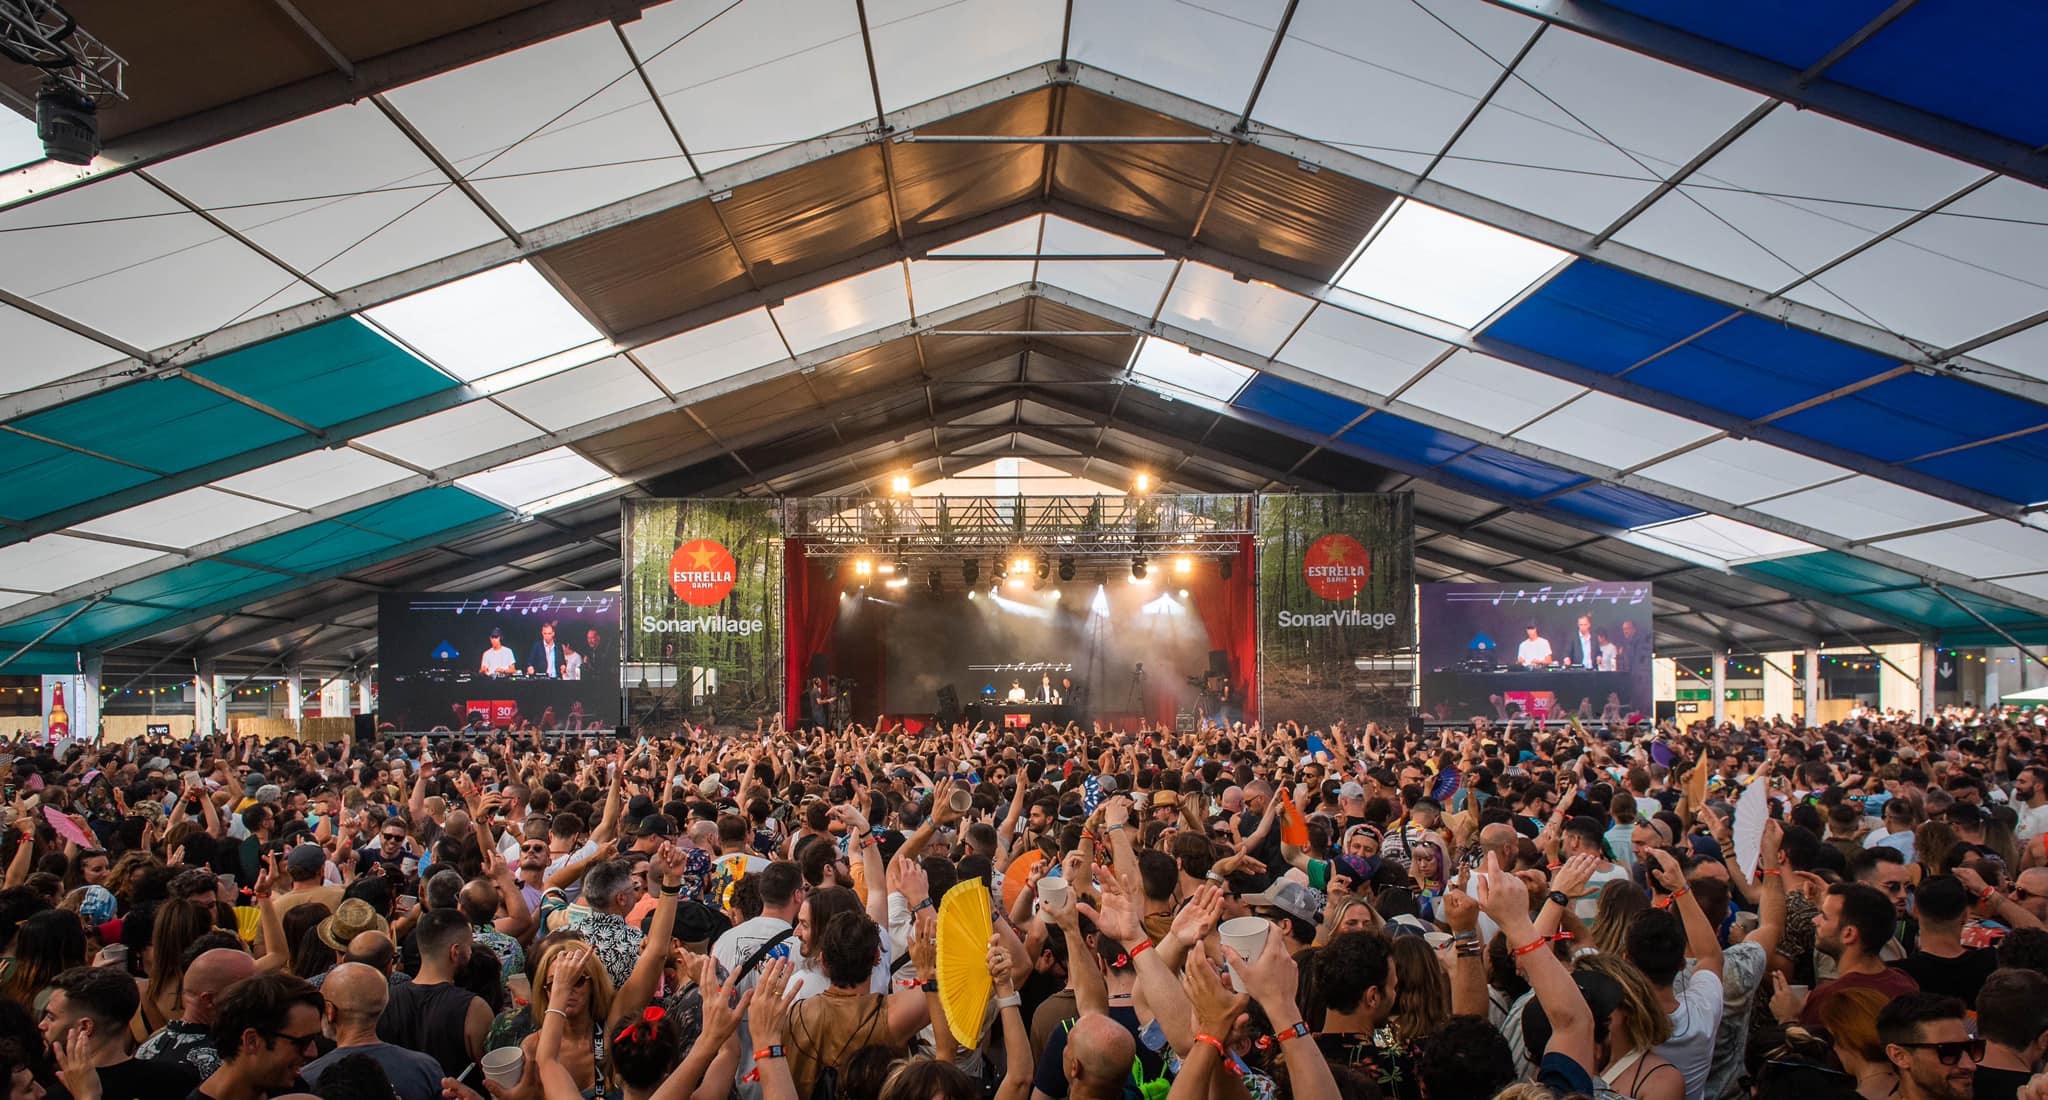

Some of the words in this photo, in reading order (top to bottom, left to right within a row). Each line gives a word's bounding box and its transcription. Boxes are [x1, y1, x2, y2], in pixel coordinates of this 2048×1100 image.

[674, 571, 731, 582] ESTRELLA
[1308, 566, 1365, 577] ESTRELLA
[643, 616, 763, 636] SonarVillage
[1278, 610, 1396, 629] SonarVillage
[594, 1039, 604, 1060] NIKE
